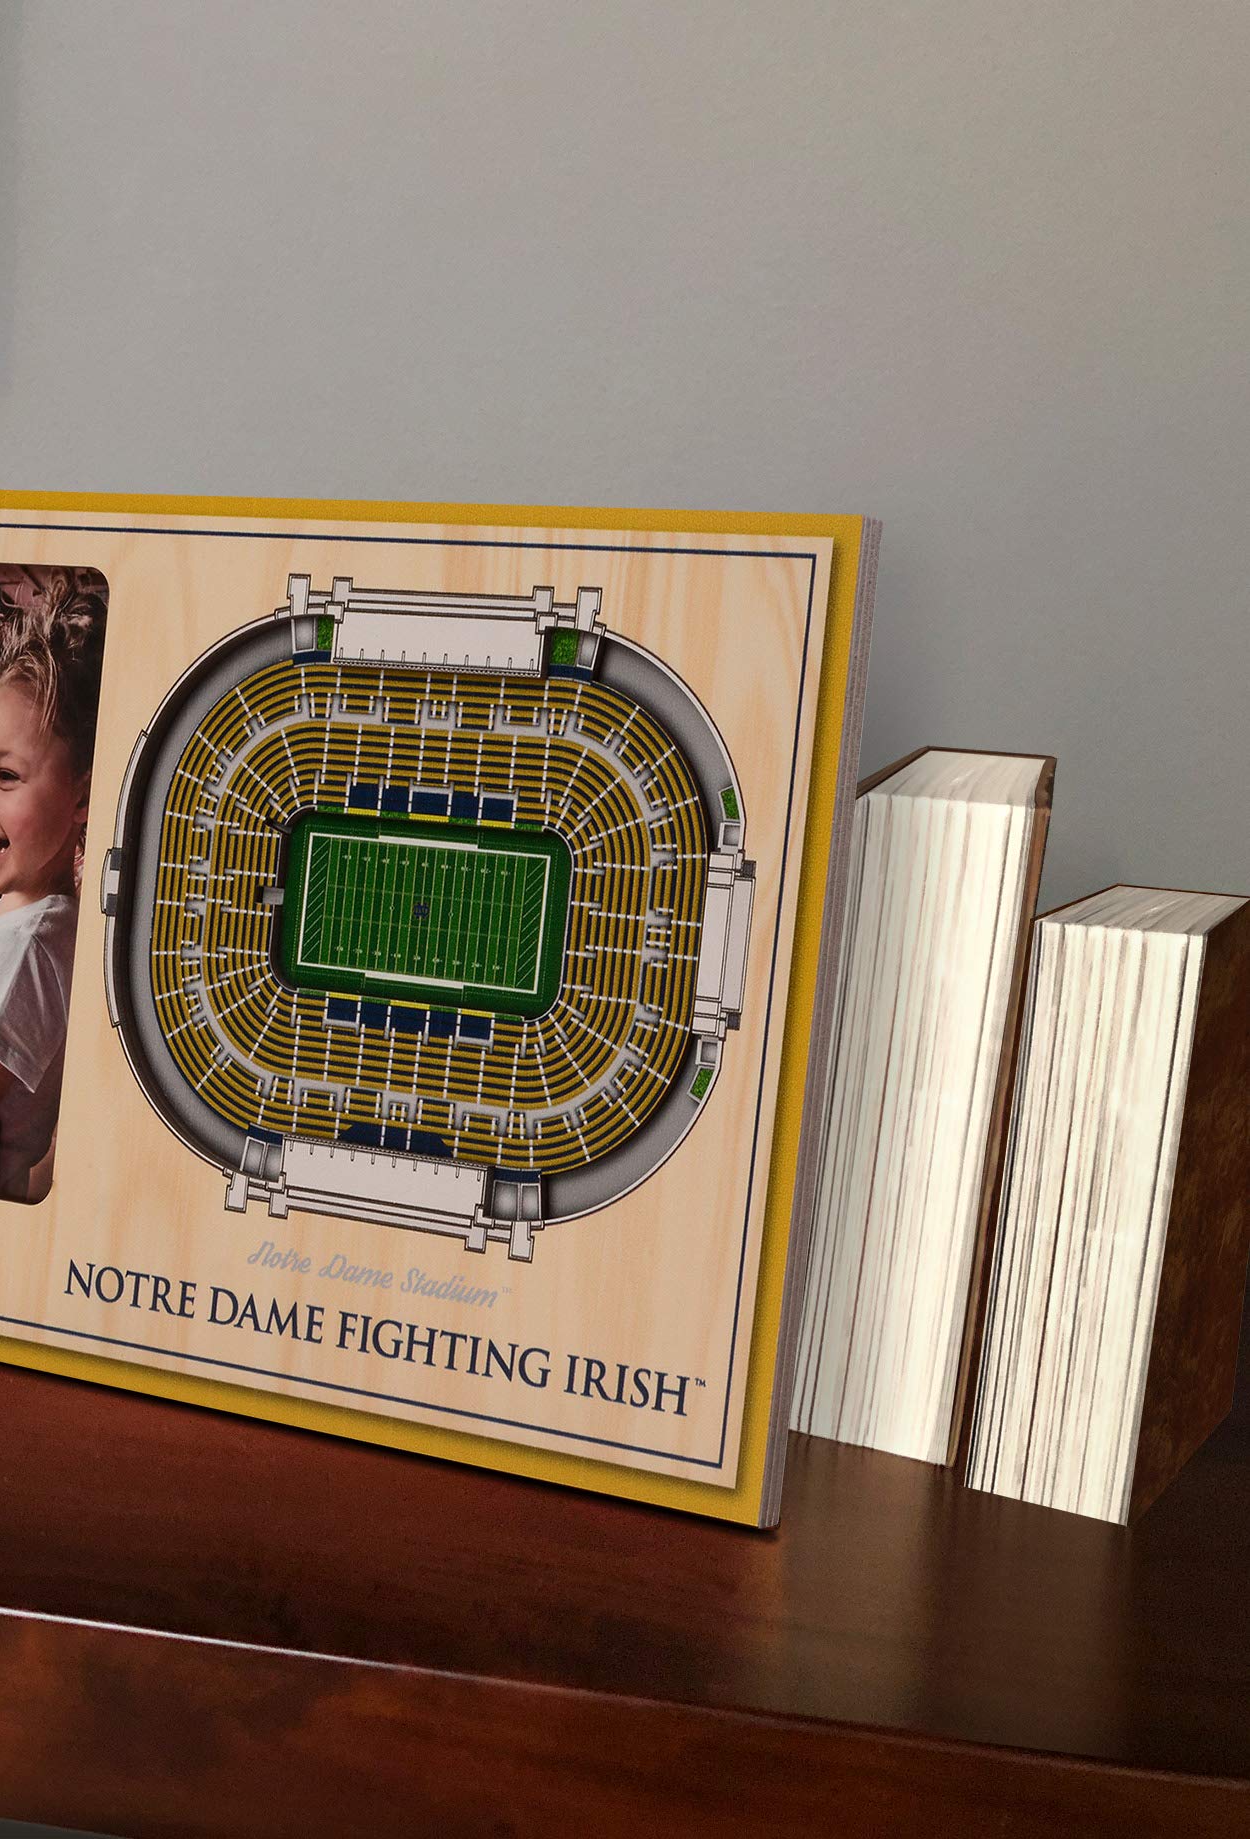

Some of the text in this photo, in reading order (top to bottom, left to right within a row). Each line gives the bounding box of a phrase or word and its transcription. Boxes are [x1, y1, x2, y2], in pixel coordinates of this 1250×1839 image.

[247, 1240, 312, 1274] Notre
[318, 1253, 394, 1289] Dame
[63, 1258, 198, 1319] NOTRE
[207, 1286, 325, 1345] DAME
[335, 1310, 551, 1389] FIGHTING
